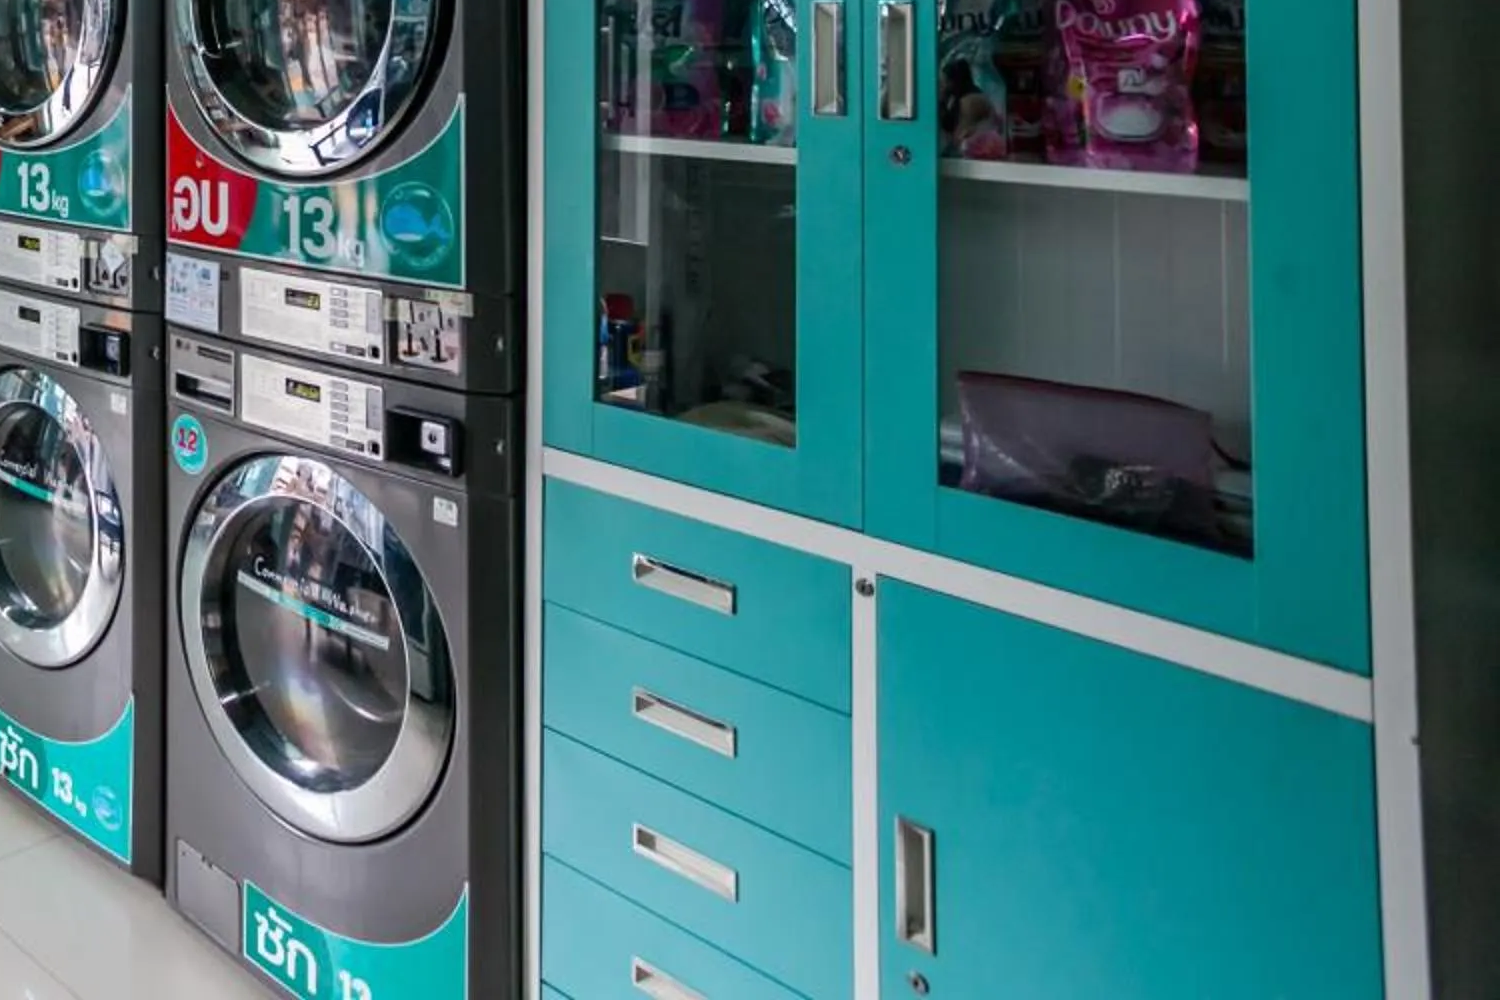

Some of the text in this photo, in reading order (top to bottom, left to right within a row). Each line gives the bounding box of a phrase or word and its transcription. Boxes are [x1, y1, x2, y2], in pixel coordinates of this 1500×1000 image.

[1056, 0, 1177, 43] Downy
[173, 176, 229, 236] อบ
[178, 427, 198, 452] 12
[0, 725, 38, 790] ชัก
[253, 906, 317, 996] ชัก
